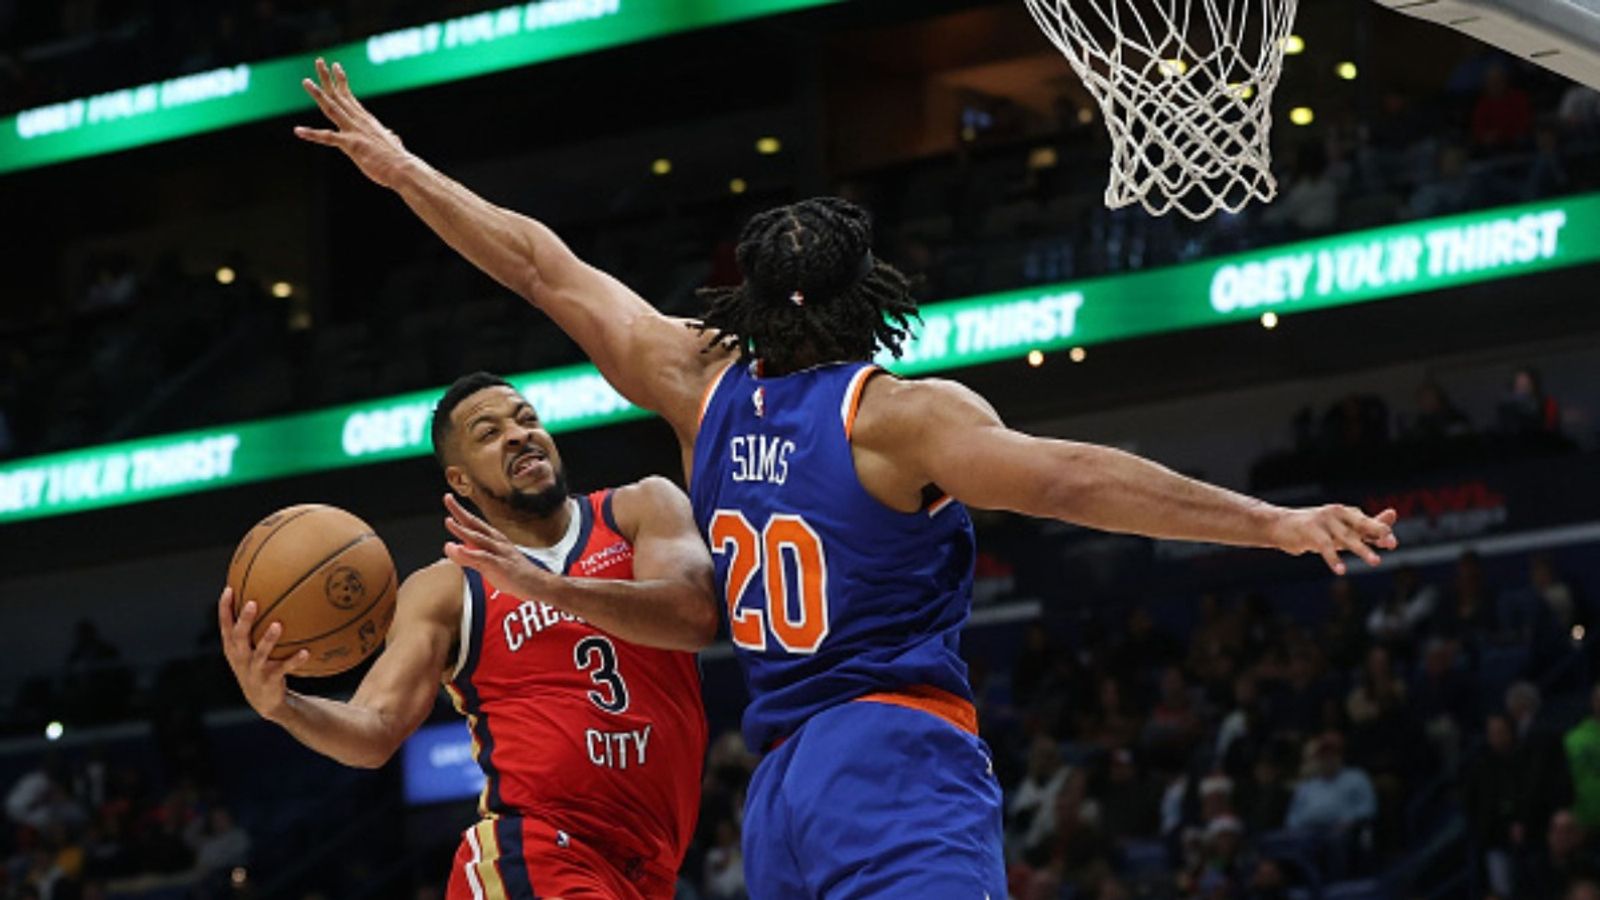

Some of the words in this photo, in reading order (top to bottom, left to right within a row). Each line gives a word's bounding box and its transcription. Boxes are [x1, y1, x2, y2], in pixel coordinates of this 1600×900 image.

[1209, 252, 1312, 312] OBEY
[1316, 234, 1423, 295] YOUR
[1424, 210, 1566, 276] THIRST
[955, 291, 1084, 353] THIRST
[342, 401, 430, 455] OBEY
[730, 434, 795, 485] SIMS
[709, 509, 829, 653] 20
[503, 600, 586, 651] CRE
[574, 635, 629, 714] 3
[585, 724, 652, 769] CITY
